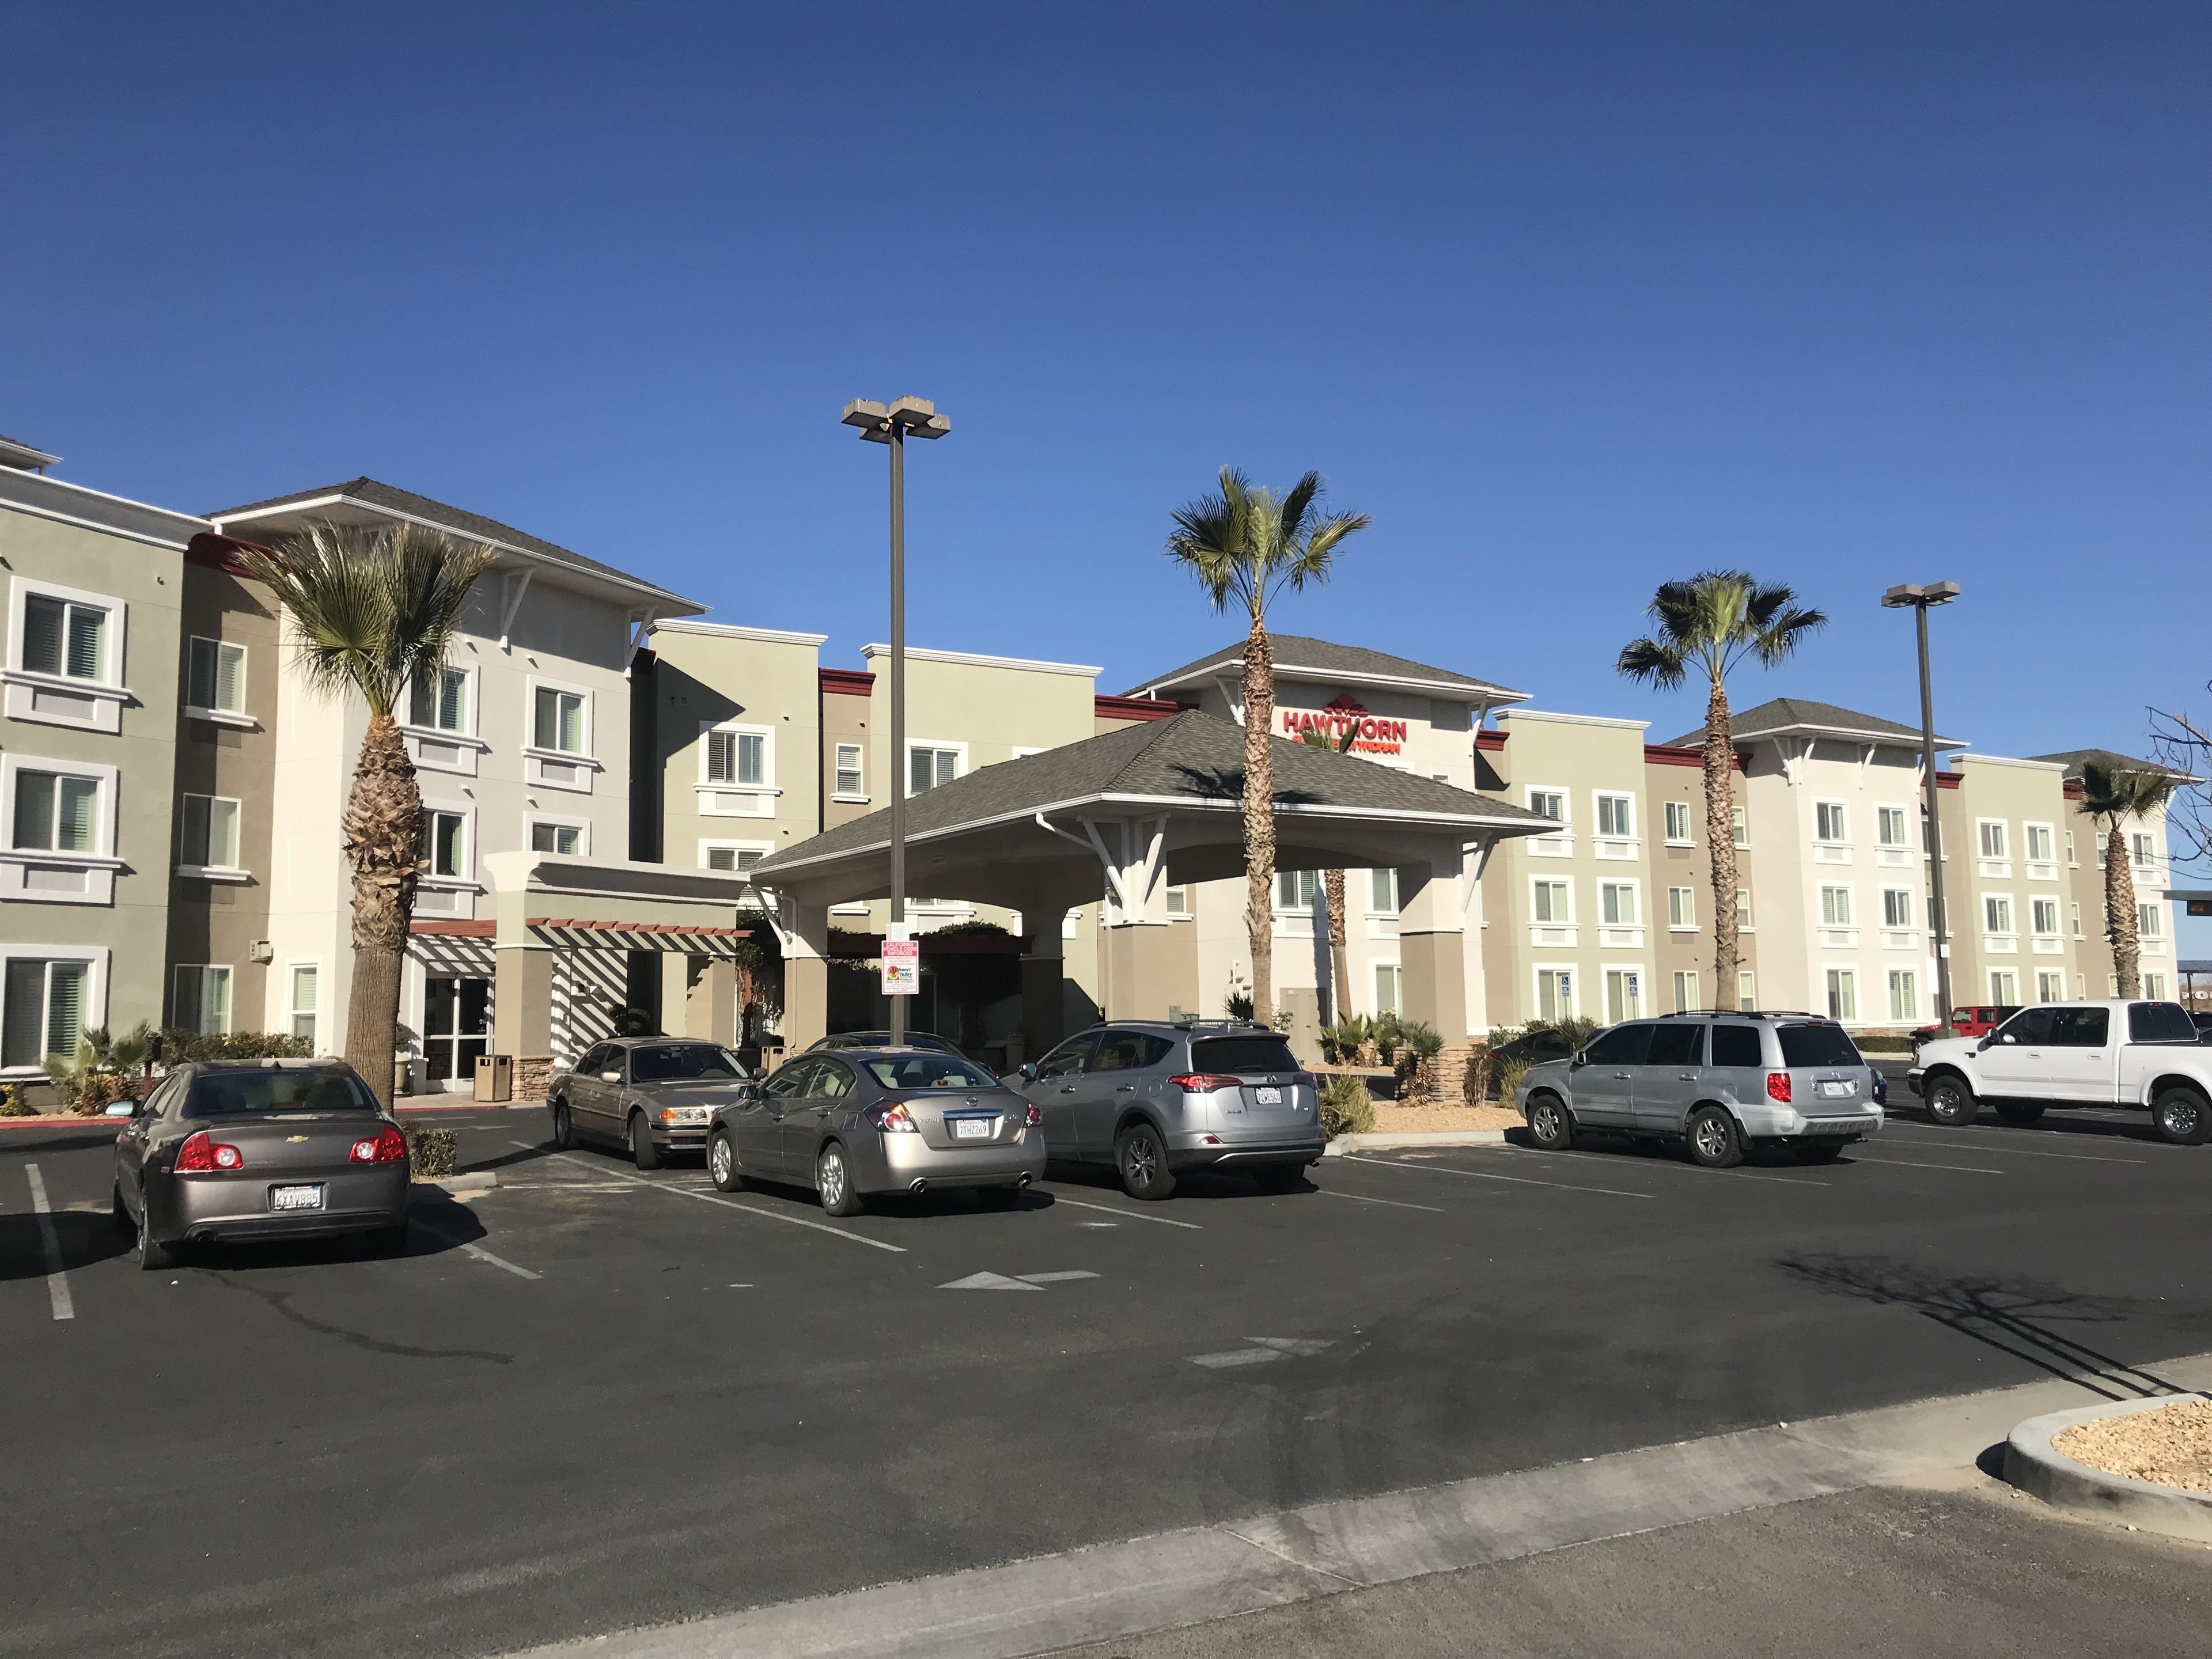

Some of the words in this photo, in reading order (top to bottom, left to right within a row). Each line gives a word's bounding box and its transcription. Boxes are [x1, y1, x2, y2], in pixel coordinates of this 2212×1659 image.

[1283, 711, 1407, 742] HAWTHORN
[2181, 990, 2212, 999] KO
[959, 1125, 987, 1135] 7THZ269
